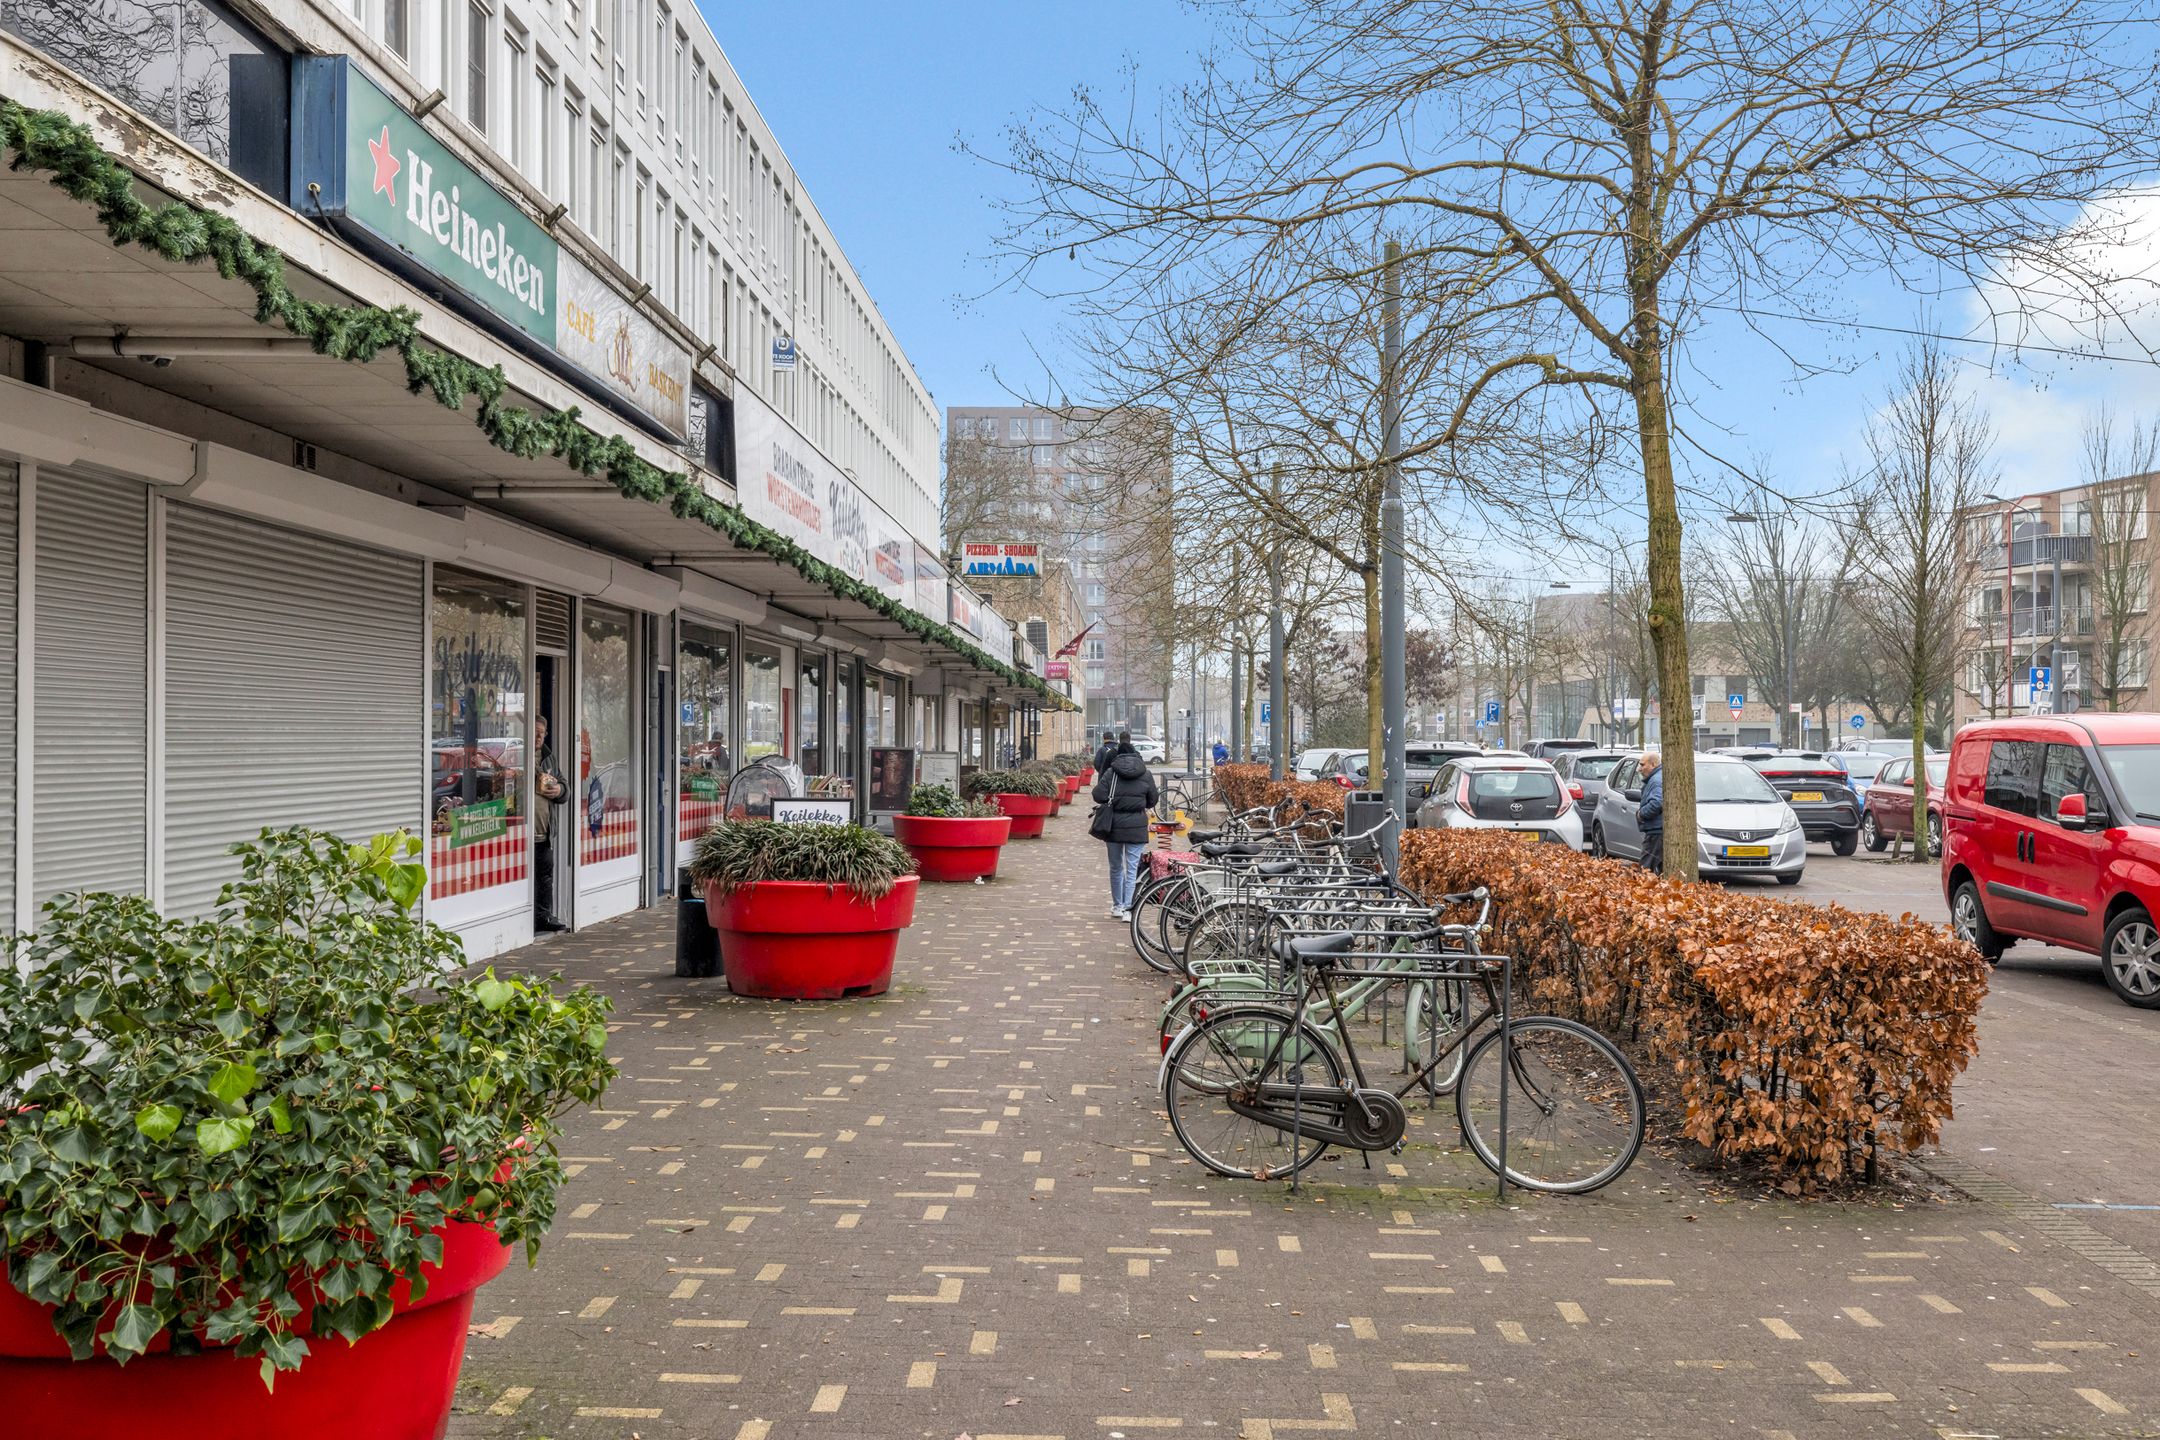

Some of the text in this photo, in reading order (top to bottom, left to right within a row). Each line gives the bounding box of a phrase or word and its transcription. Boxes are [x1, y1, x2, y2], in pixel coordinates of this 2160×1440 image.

[407, 149, 545, 316] Heineken
[567, 301, 596, 344] CAFÉ
[966, 544, 998, 556] PIZZERIA
[1004, 544, 1037, 557] SHOARMA
[966, 556, 1036, 576] ARMADA
[779, 809, 843, 824] Keilekker
